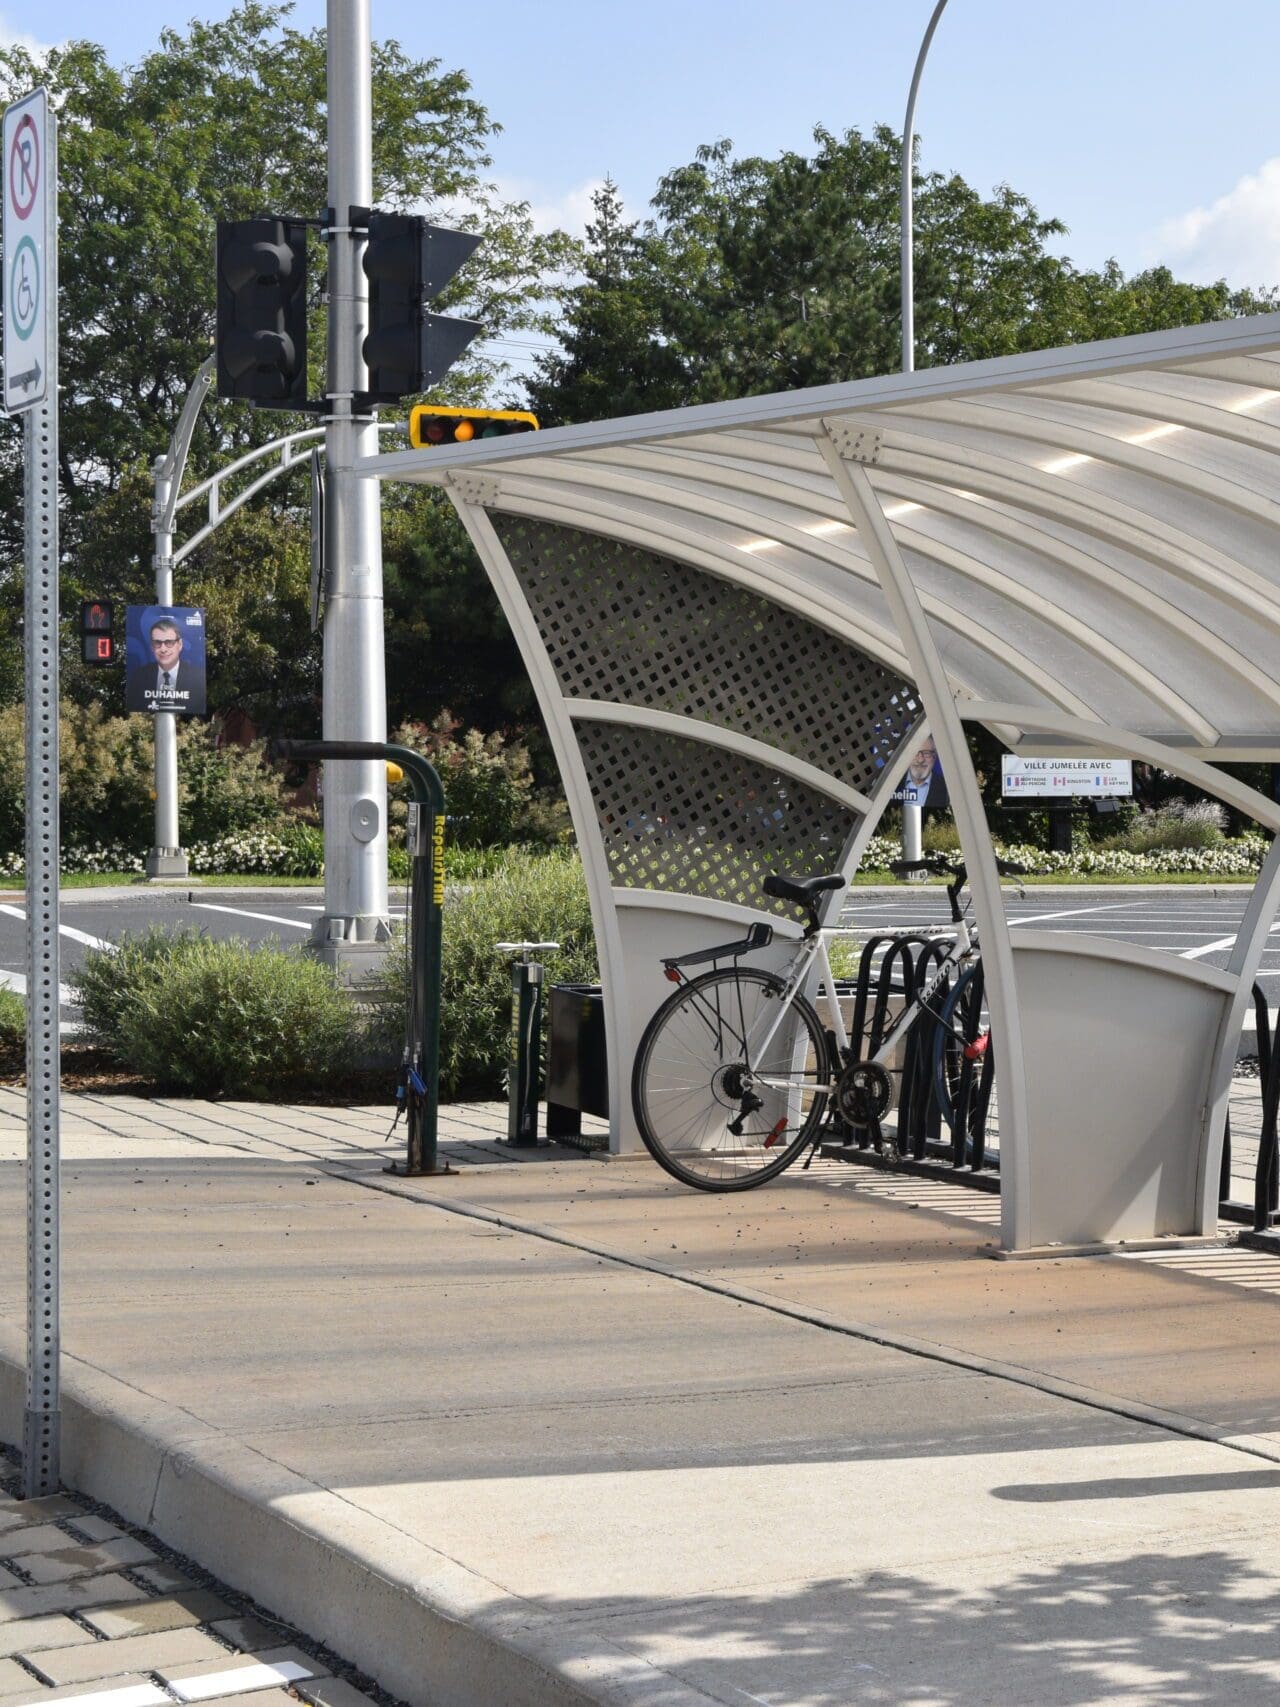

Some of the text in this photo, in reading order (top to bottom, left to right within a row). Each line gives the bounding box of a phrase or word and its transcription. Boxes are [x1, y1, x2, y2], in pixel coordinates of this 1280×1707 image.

[144, 690, 190, 700] DUHAIME
[1024, 762, 1047, 770] VILLE
[1049, 761, 1088, 770] JUMELÉE
